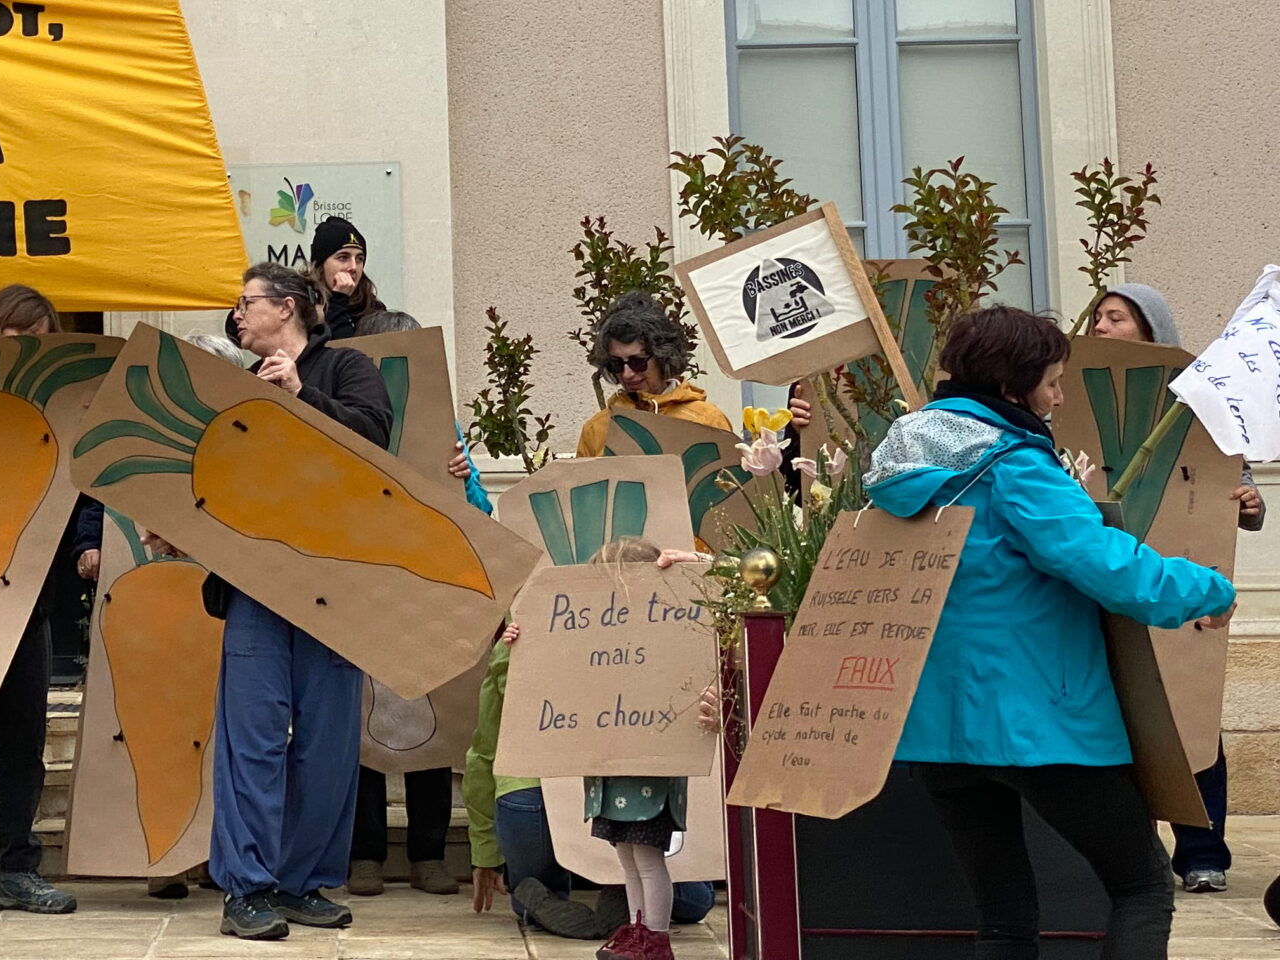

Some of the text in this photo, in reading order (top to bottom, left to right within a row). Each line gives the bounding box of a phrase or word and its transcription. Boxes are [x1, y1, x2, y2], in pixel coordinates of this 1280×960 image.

[313, 200, 352, 211] Brissac
[267, 244, 310, 266] MA
[744, 263, 804, 297] BASSINES
[769, 322, 788, 336] NON
[788, 310, 816, 328] MERCI
[1238, 352, 1262, 373] des
[1207, 375, 1231, 391] de
[822, 546, 957, 572] L'EAU DE PLUIE
[866, 587, 900, 605] VERS
[910, 588, 933, 605] LA
[549, 591, 701, 633] Pas de trou
[822, 622, 843, 637] ELLE
[849, 621, 874, 638] EST
[879, 623, 932, 640] PERDUE
[590, 642, 645, 666] mais
[835, 656, 901, 685] FAUX
[538, 699, 578, 732] Des
[767, 702, 791, 720] Elle
[829, 704, 866, 723] partie
[873, 706, 891, 721] du
[794, 728, 836, 743] naturel
[843, 730, 859, 746] de
